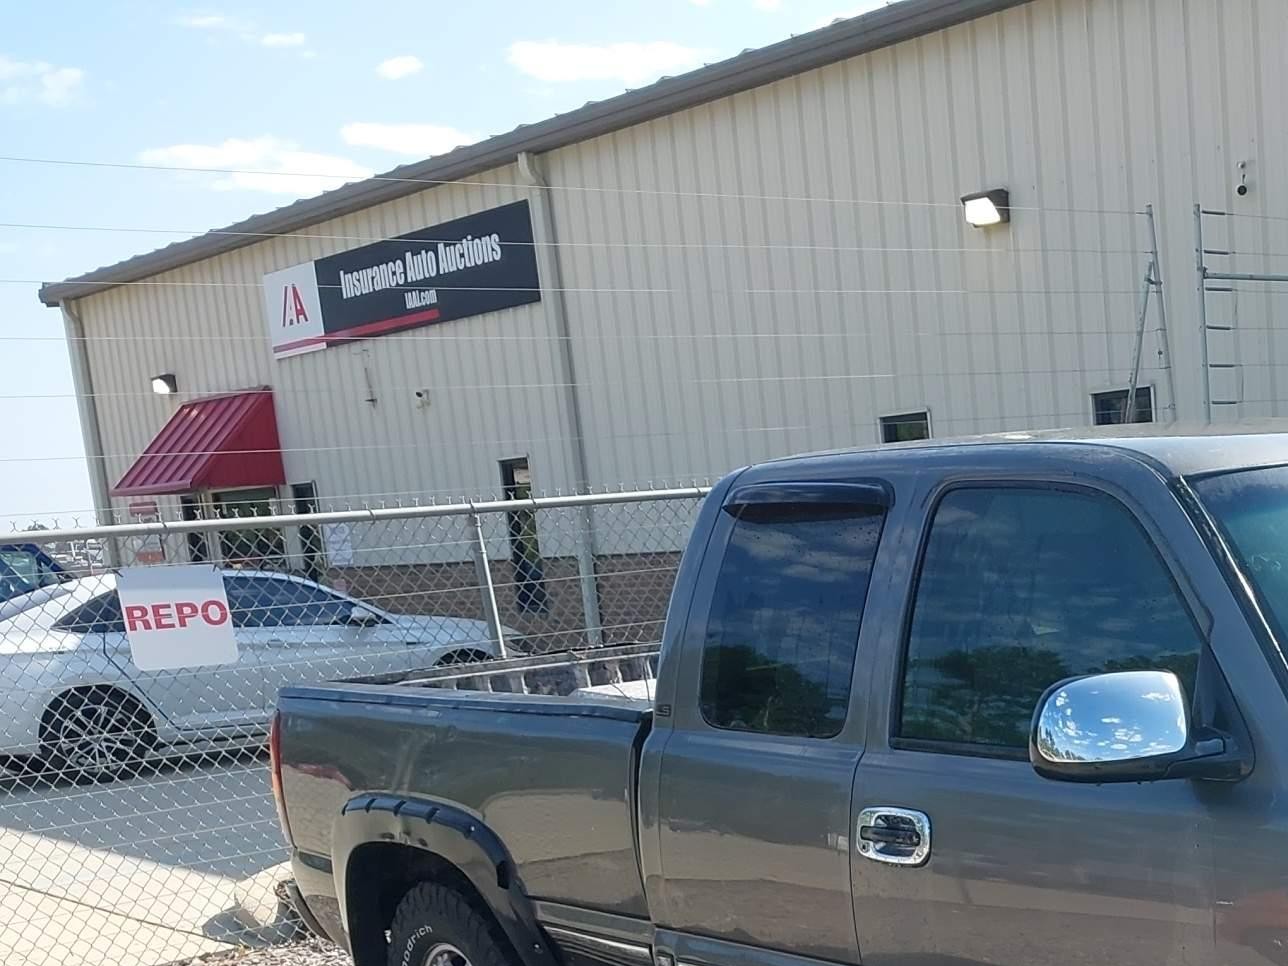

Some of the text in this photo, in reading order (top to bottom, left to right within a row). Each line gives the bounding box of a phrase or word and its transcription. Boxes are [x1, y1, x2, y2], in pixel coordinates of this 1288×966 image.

[339, 233, 502, 299] Insurance Auto Auctions
[125, 600, 228, 632] REPO
